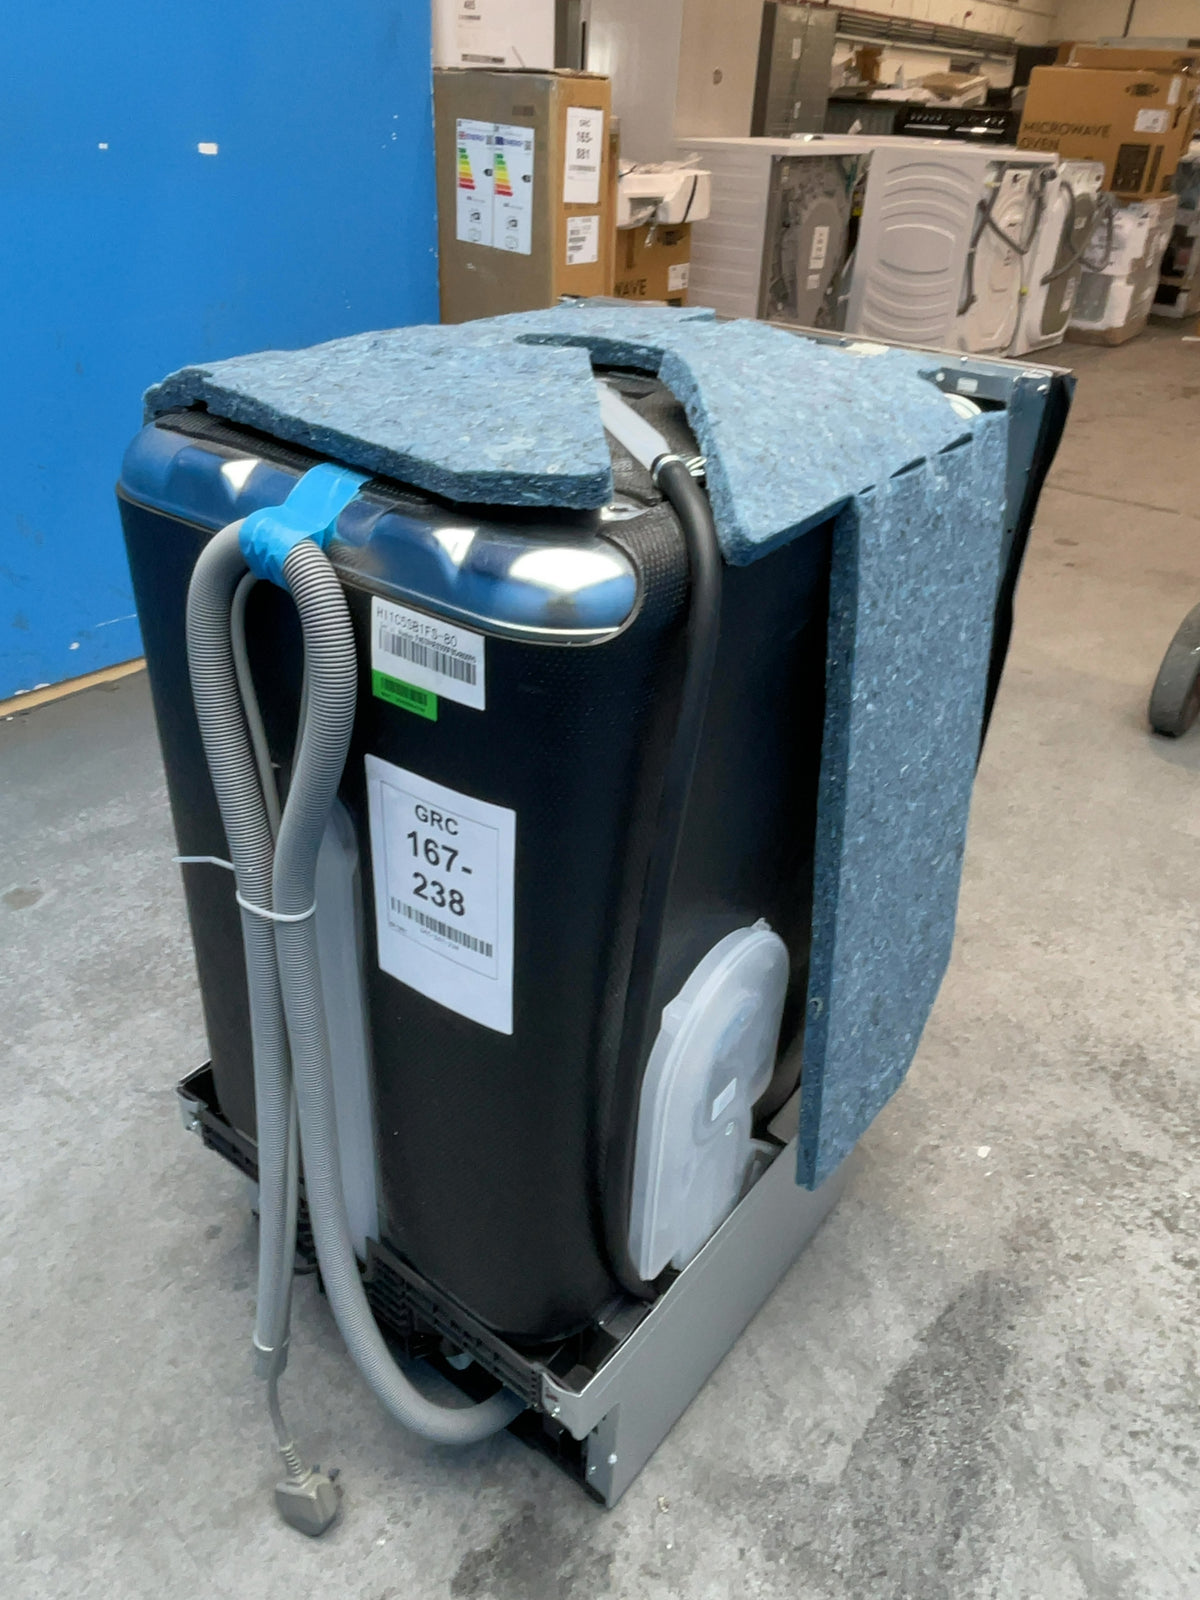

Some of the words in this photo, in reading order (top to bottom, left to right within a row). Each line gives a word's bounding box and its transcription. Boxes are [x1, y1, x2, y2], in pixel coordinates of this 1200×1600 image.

[1018, 136, 1060, 151] OVEN
[1022, 121, 1112, 138] MICROWAVE
[415, 804, 459, 836] GRC
[407, 830, 473, 873] 167-
[412, 871, 466, 917] 238
